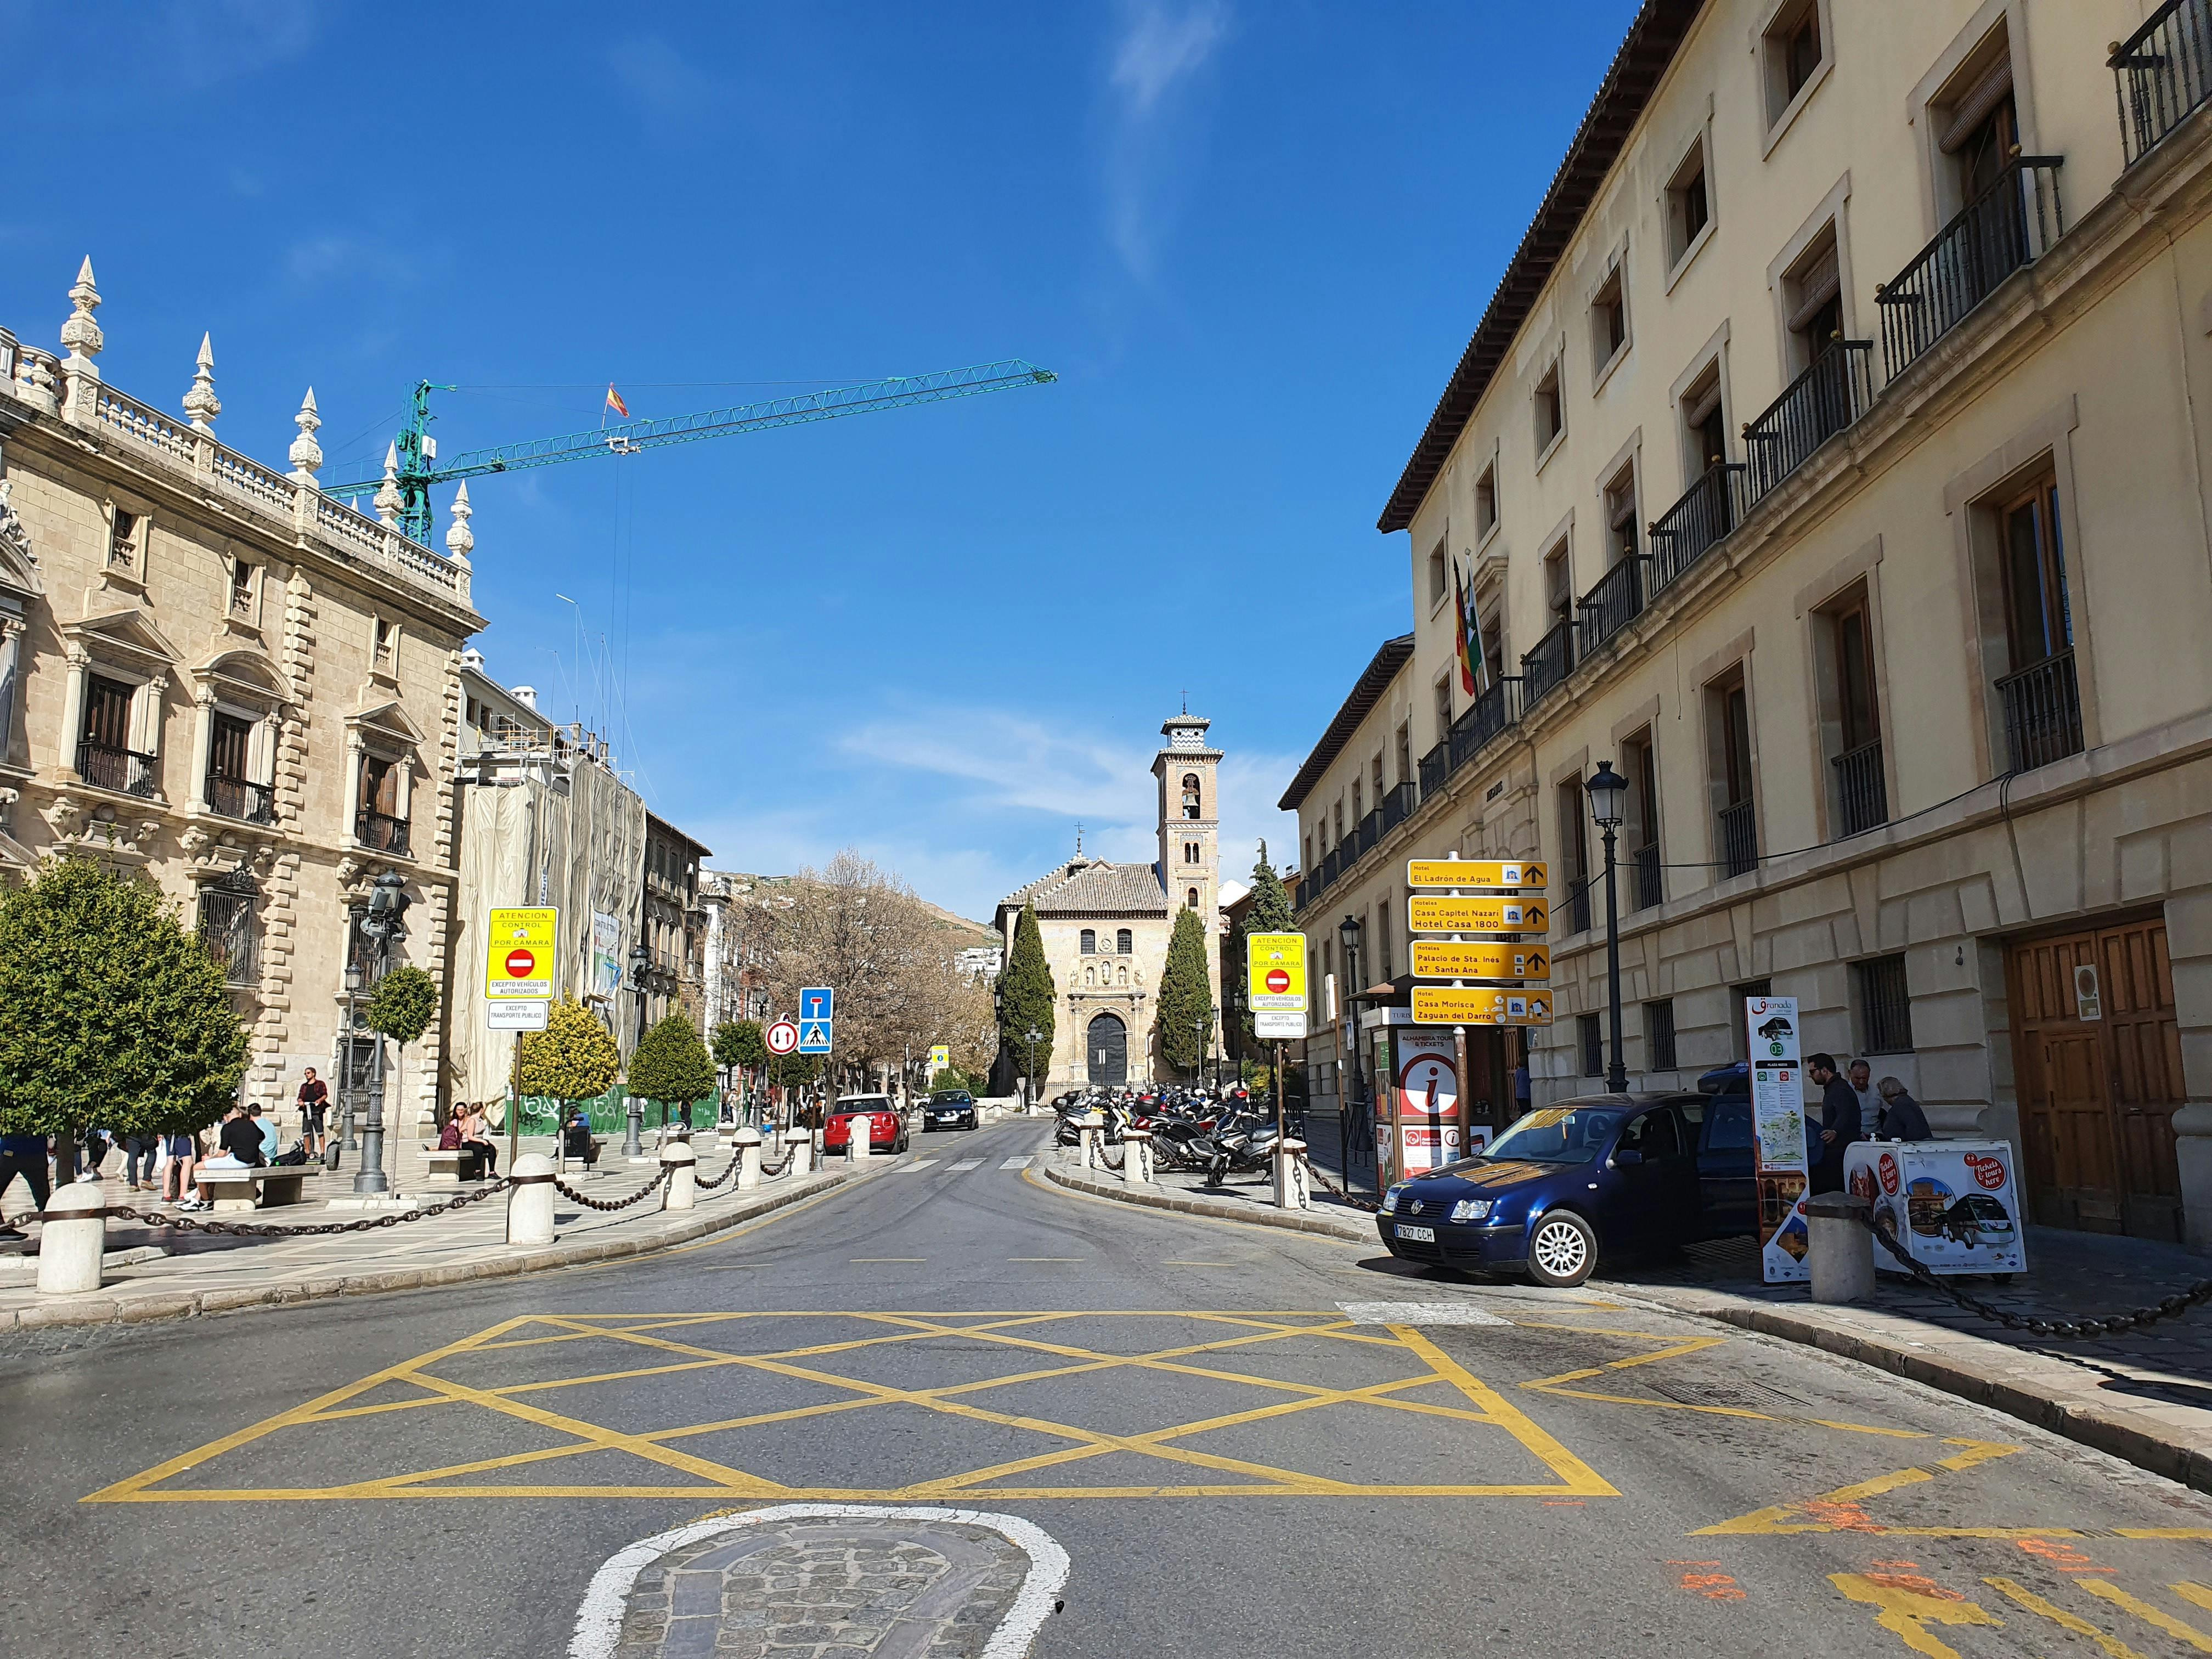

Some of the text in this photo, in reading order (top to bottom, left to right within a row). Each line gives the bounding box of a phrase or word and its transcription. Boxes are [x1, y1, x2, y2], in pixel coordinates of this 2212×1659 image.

[1418, 1011, 1449, 1020] Zaguán
[1771, 1045, 1782, 1054] 03
[1975, 1161, 1998, 1173] Tickets
[1985, 1167, 2002, 1178] tours
[1985, 1176, 2000, 1186] here
[1398, 1226, 1432, 1240] 7827 CCH
